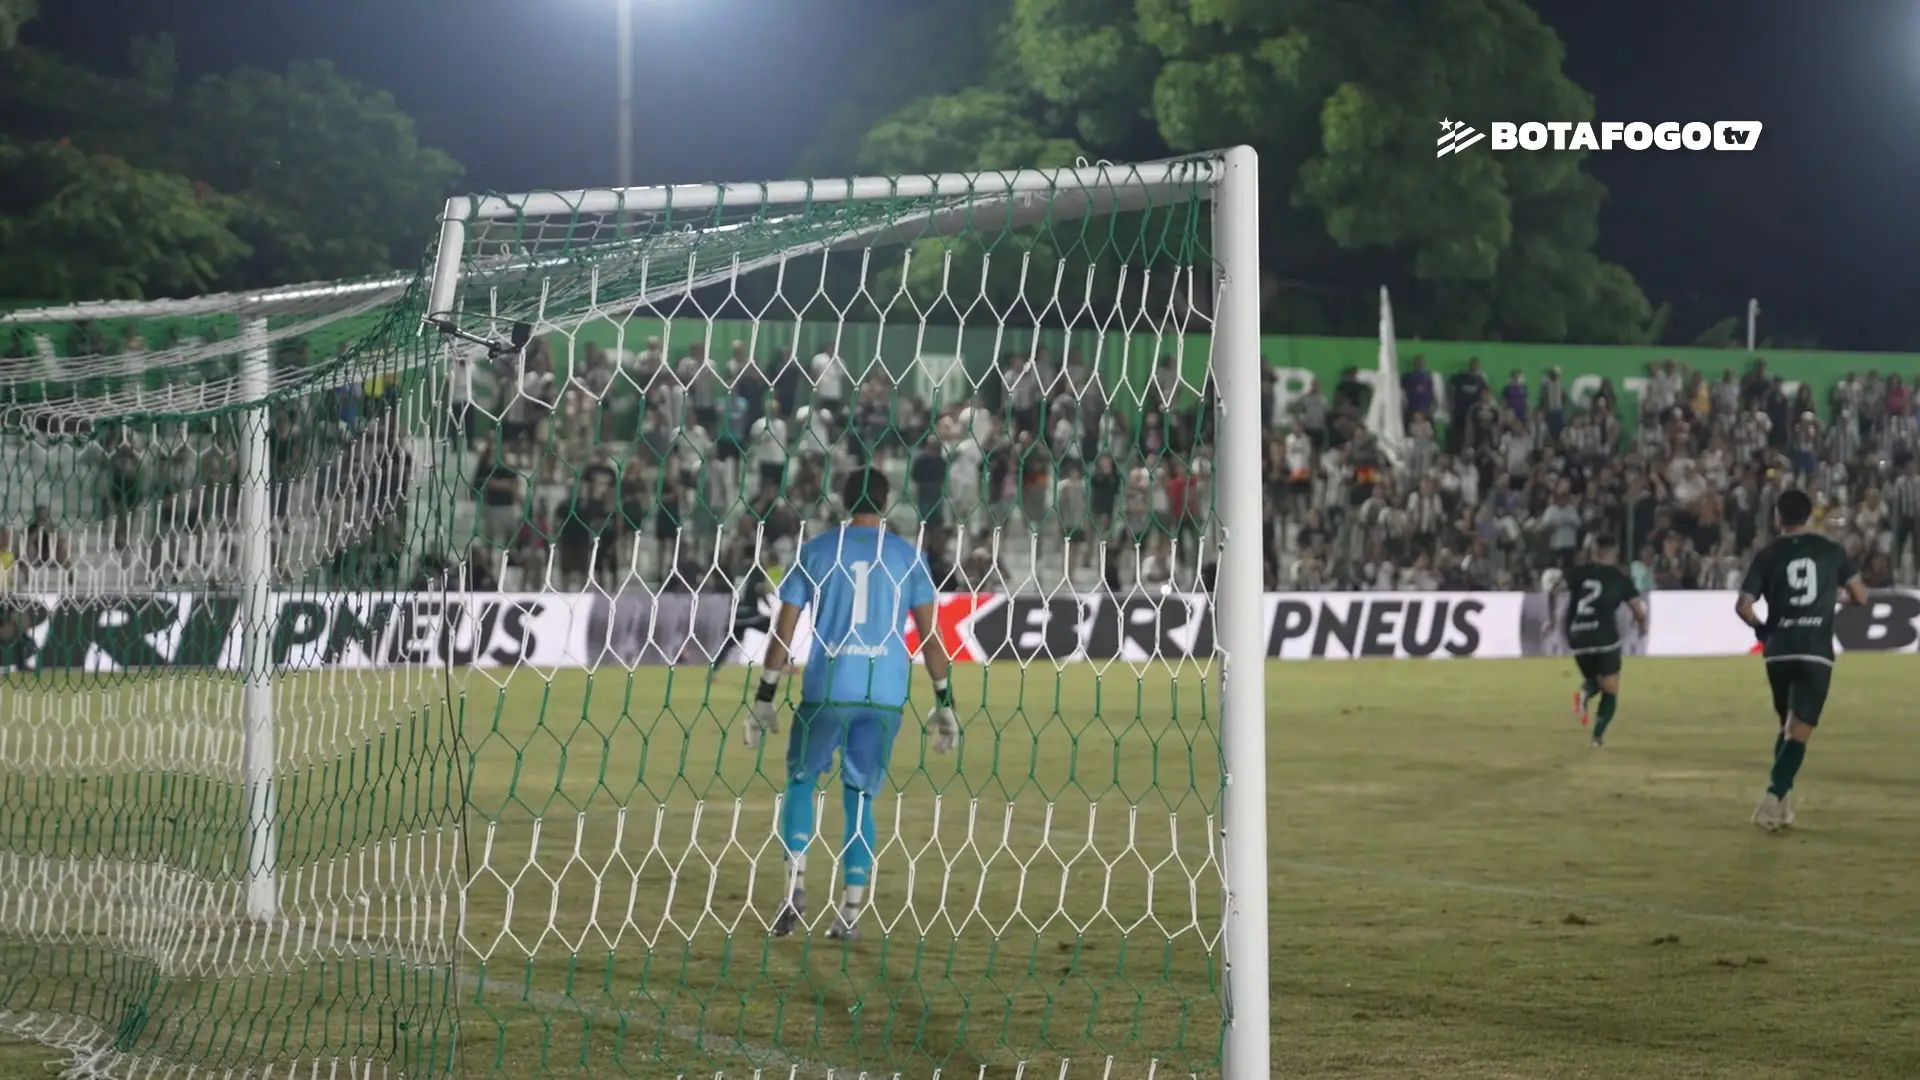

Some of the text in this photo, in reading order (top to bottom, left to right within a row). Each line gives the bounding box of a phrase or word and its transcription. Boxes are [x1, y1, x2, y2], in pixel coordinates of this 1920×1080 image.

[849, 560, 869, 624] 1
[1577, 578, 1603, 614] 2
[1786, 557, 1817, 606] 9
[272, 600, 545, 664] PNEUS
[1266, 600, 1485, 657] PNEUS
